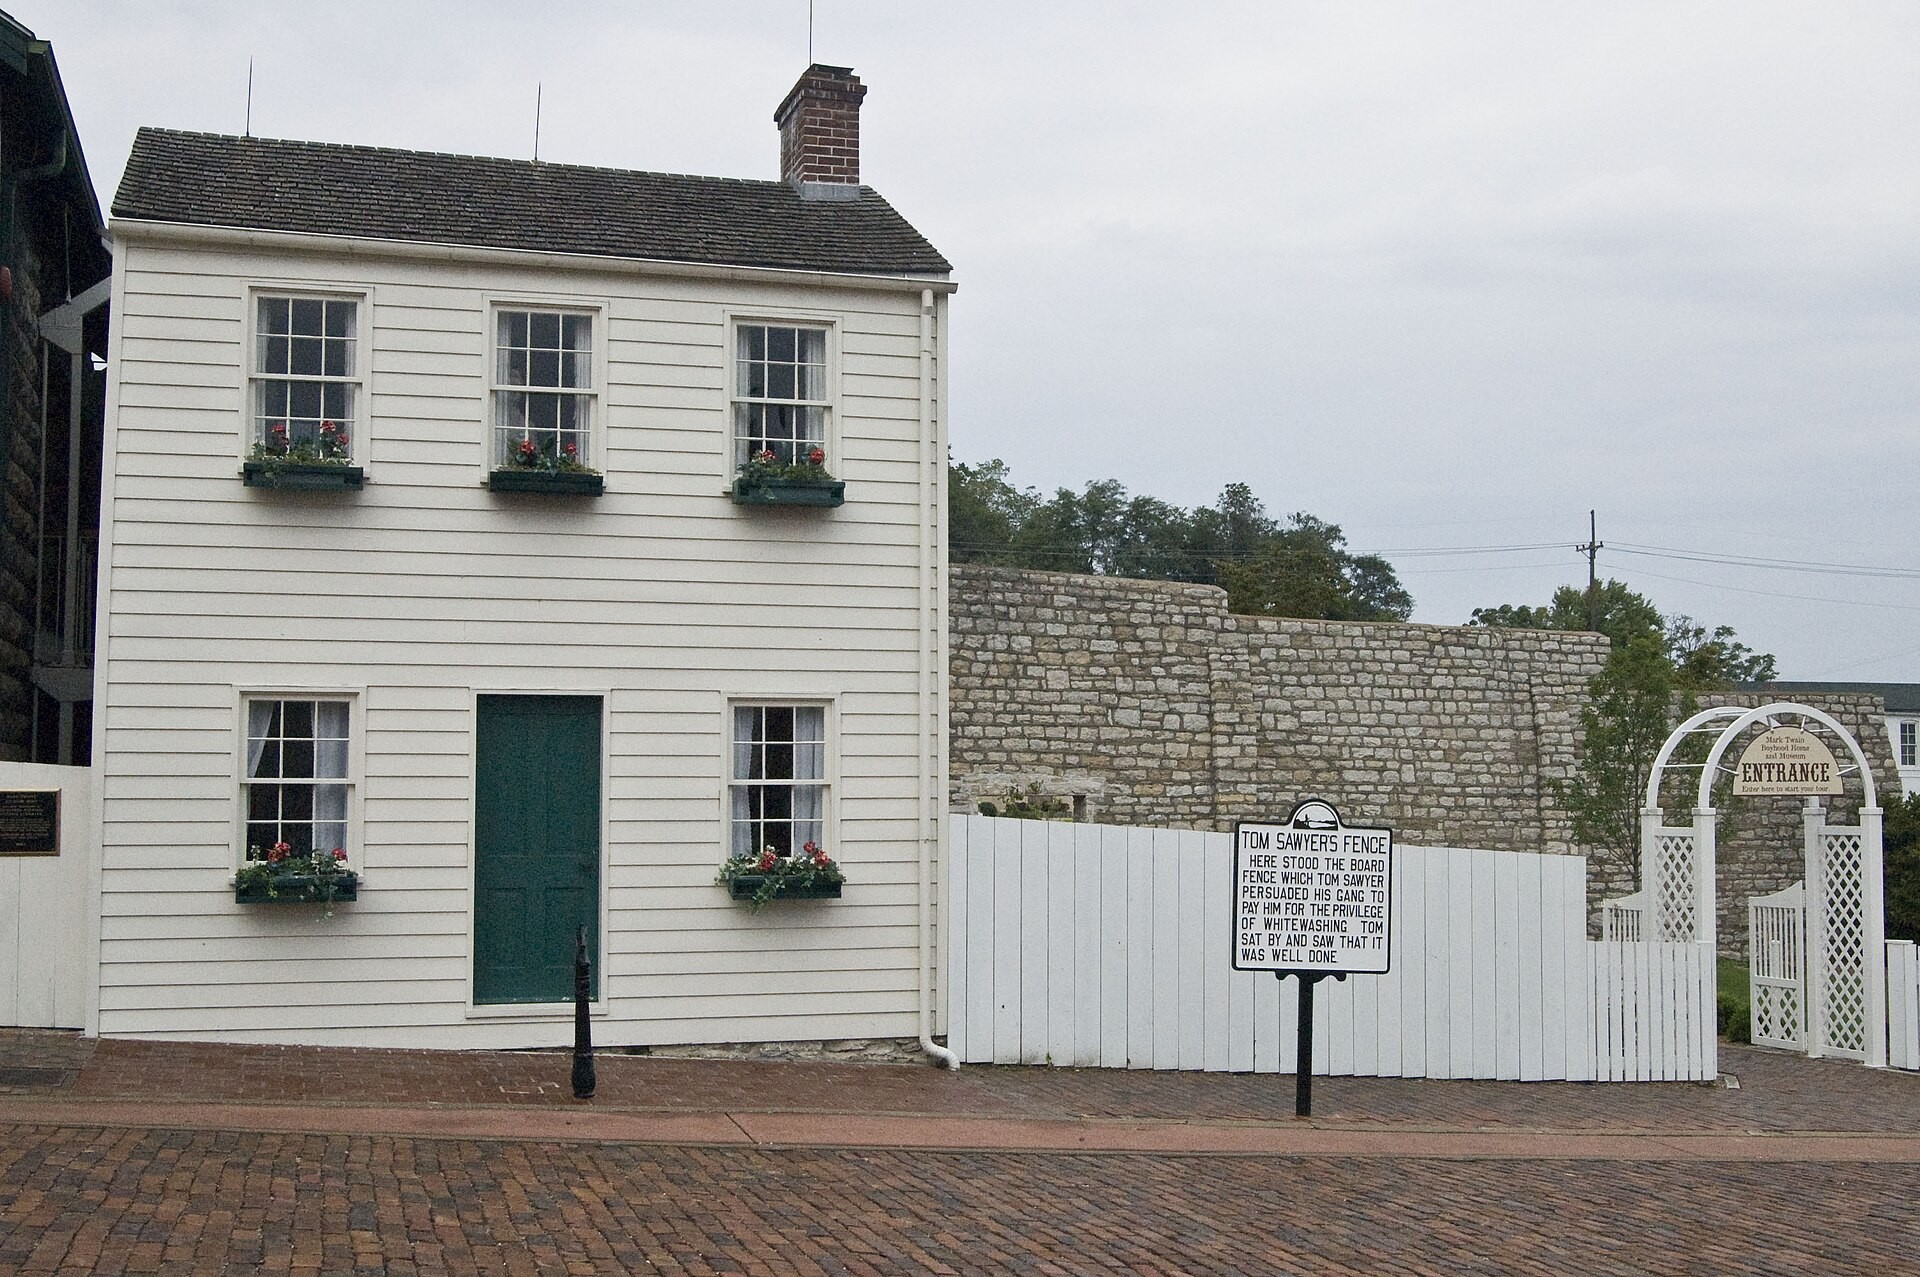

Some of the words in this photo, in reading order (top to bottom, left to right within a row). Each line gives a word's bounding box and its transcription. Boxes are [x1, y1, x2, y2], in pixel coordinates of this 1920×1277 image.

[1761, 744, 1788, 752] Boyhood
[1742, 763, 1830, 782] ENTRANCE
[1242, 831, 1269, 849] TOM
[1276, 832, 1338, 852] SAWYER'S
[1344, 835, 1387, 854] FENCE
[1250, 855, 1277, 868] HERE
[1283, 856, 1319, 869] STOOD
[1325, 858, 1345, 870] THE
[1351, 859, 1384, 872] BOARD
[1243, 870, 1276, 883] FENCE
[1281, 872, 1313, 885] WHICH
[1318, 873, 1339, 886] TOM
[1344, 874, 1384, 887] SAWYER
[1242, 886, 1308, 900] PERSUADED
[1314, 889, 1331, 900] HIS
[1337, 890, 1364, 902] GANG
[1371, 891, 1384, 903] TO
[1242, 902, 1259, 914] PAY
[1263, 902, 1281, 915] HIM
[1285, 903, 1304, 915] FOR
[1310, 904, 1330, 916] THE
[1333, 904, 1384, 918] PRIVILEGE
[1242, 917, 1256, 930] OF
[1361, 921, 1383, 933] TOM
[1242, 933, 1262, 946] SAT
[1268, 934, 1281, 946] BY
[1286, 934, 1307, 946] AND
[1313, 936, 1334, 948] SAW
[1340, 936, 1368, 949] THAT
[1373, 937, 1383, 949] IT
[1242, 949, 1265, 961] WAS
[1272, 950, 1303, 962] WELL
